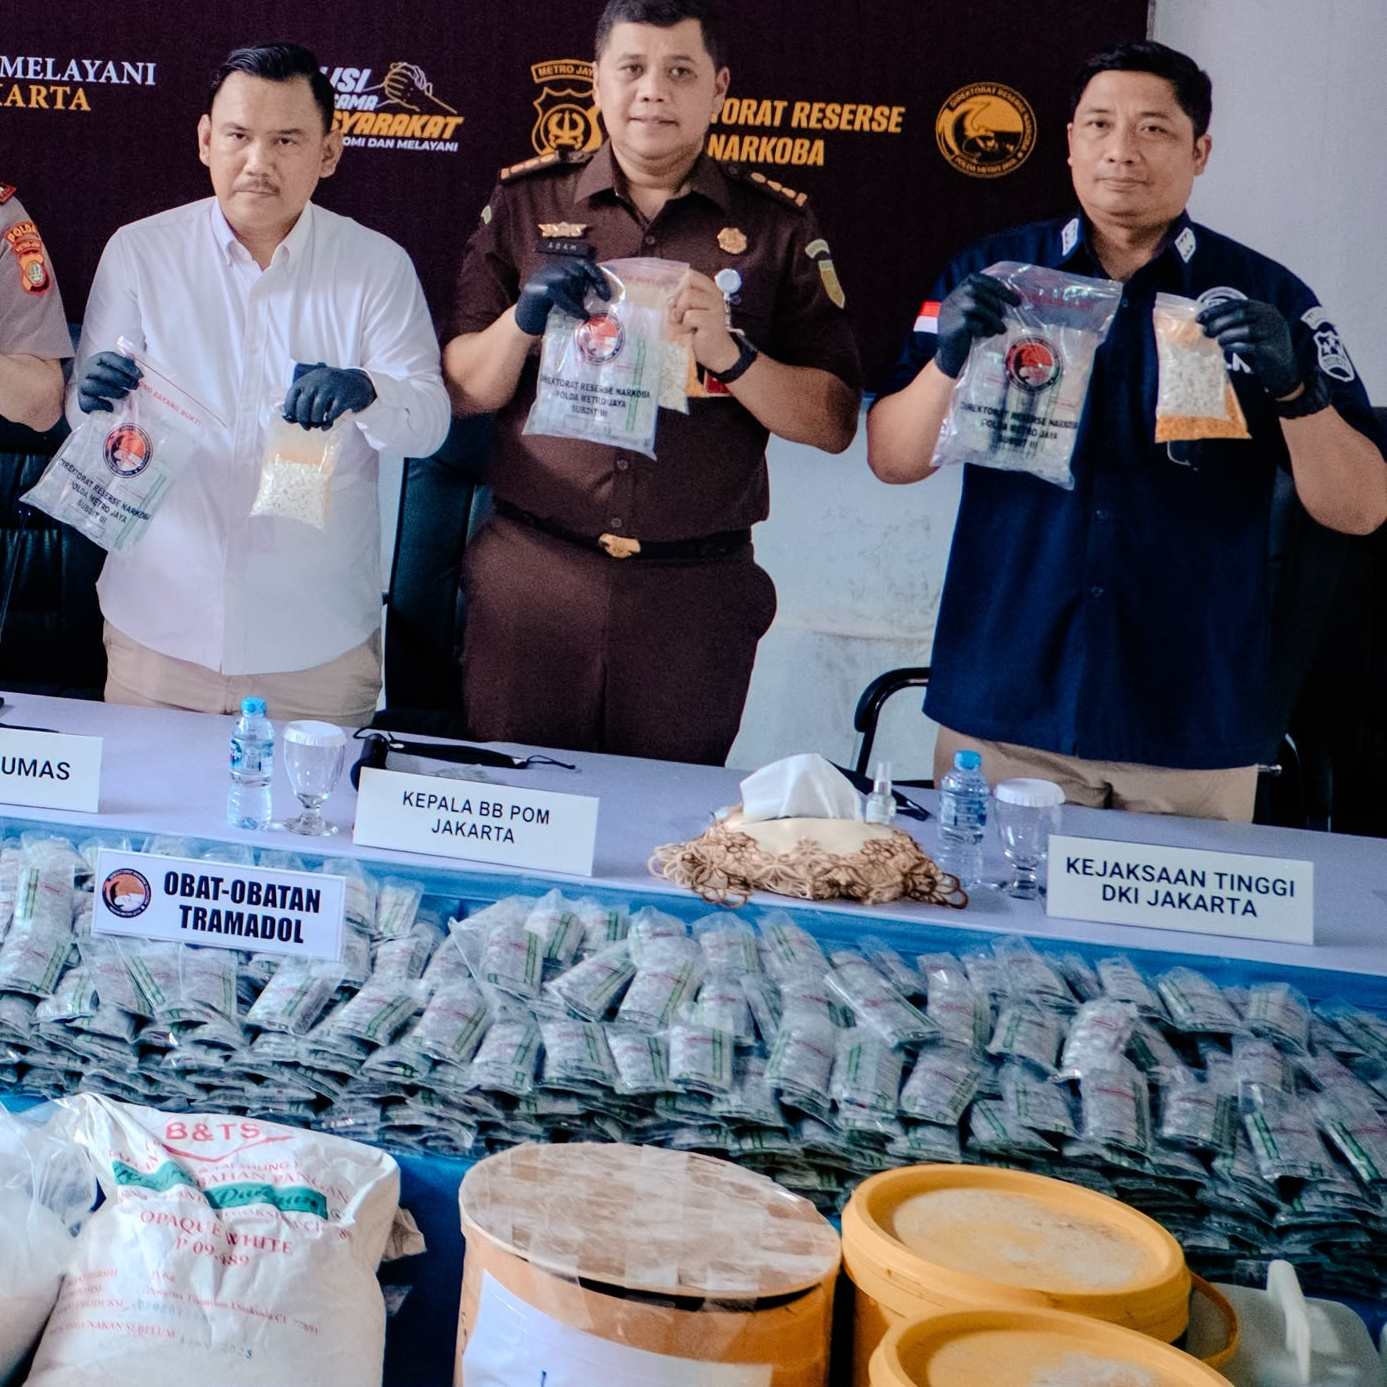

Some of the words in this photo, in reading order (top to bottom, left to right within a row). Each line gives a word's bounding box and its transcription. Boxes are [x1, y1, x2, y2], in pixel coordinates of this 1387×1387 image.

[791, 101, 905, 133] RESERSE
[707, 134, 824, 165] NARKOBA
[6, 222, 38, 242] POLDA
[548, 242, 576, 251] ADAM
[77, 499, 99, 518] SUBDIT
[90, 494, 110, 513] METRO
[111, 508, 127, 523] JAYA
[93, 484, 121, 506] RESERSE
[403, 791, 472, 814] KEPALA
[479, 801, 503, 818] BB
[510, 805, 549, 824] POM
[431, 819, 514, 844] JAKARTA
[164, 870, 321, 913] OBAT-OBATAN
[1067, 857, 1206, 888] KEJAKSAAN
[1214, 872, 1294, 897] TINGGI
[1102, 884, 1138, 904] DKI
[1147, 890, 1257, 917] JAKARTA
[179, 905, 304, 944] TRAMADOL
[166, 1123, 261, 1142] B&TS
[140, 1212, 221, 1237] OPAQUE
[227, 1233, 293, 1255] WHITE
